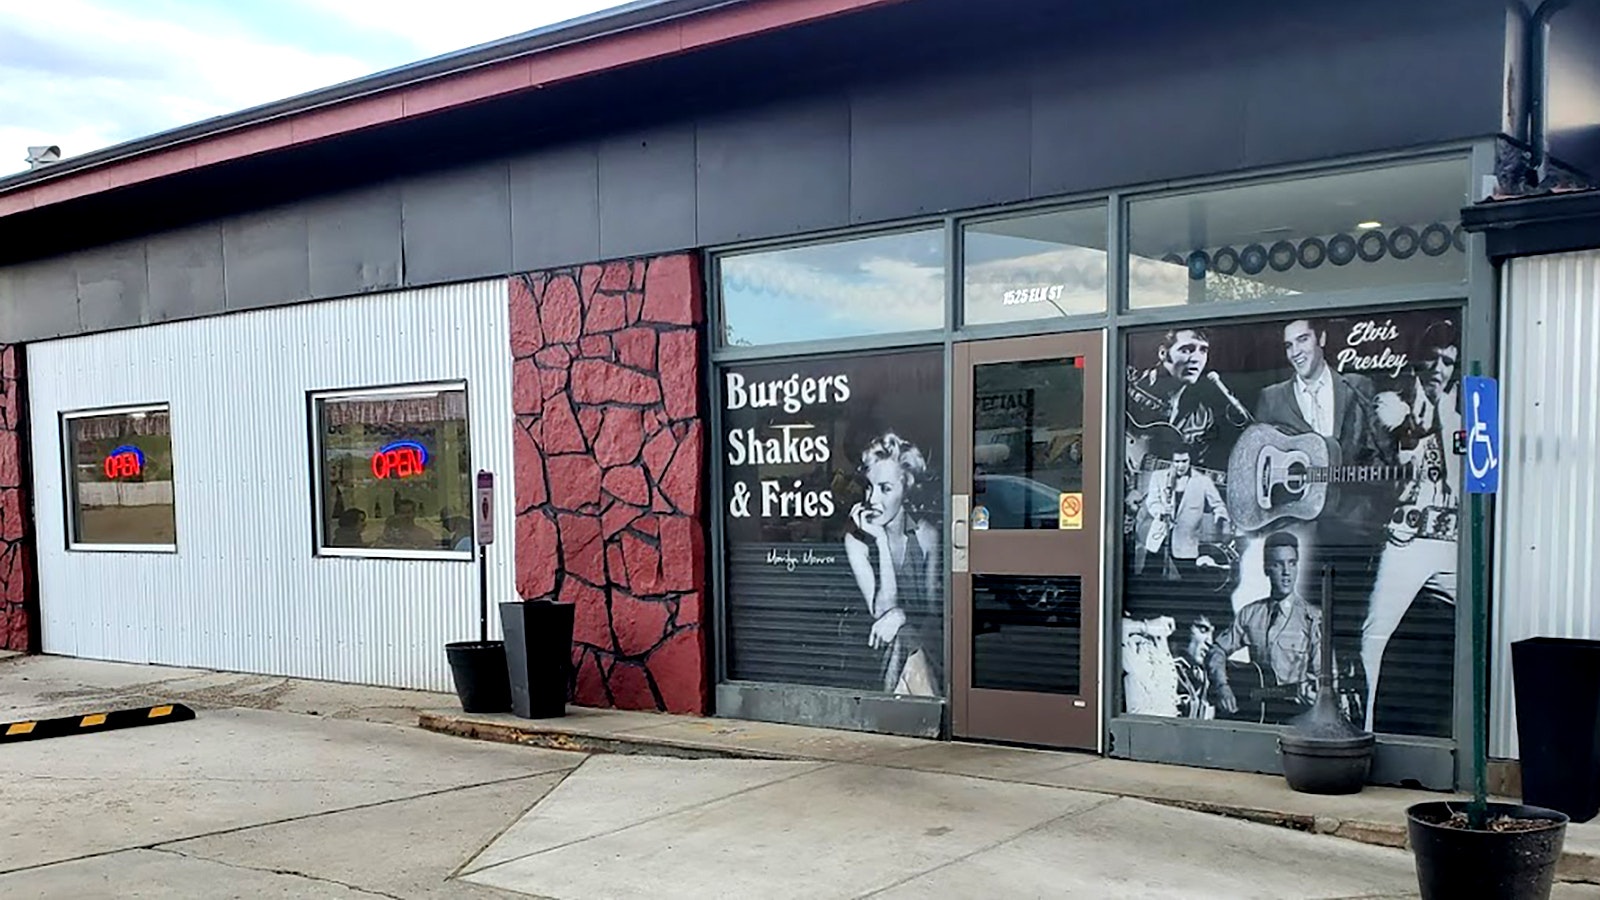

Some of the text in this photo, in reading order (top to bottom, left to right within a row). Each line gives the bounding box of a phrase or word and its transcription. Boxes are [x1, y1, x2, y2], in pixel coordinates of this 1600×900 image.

[1003, 285, 1064, 305] 1525 ELK ST
[1346, 319, 1399, 346] Elvis
[1337, 347, 1408, 378] Presley
[727, 373, 850, 413] Burgers
[728, 427, 830, 465] Shakes
[104, 453, 140, 479] OPEN
[371, 448, 424, 479] OPEN
[730, 480, 834, 518] & Fries
